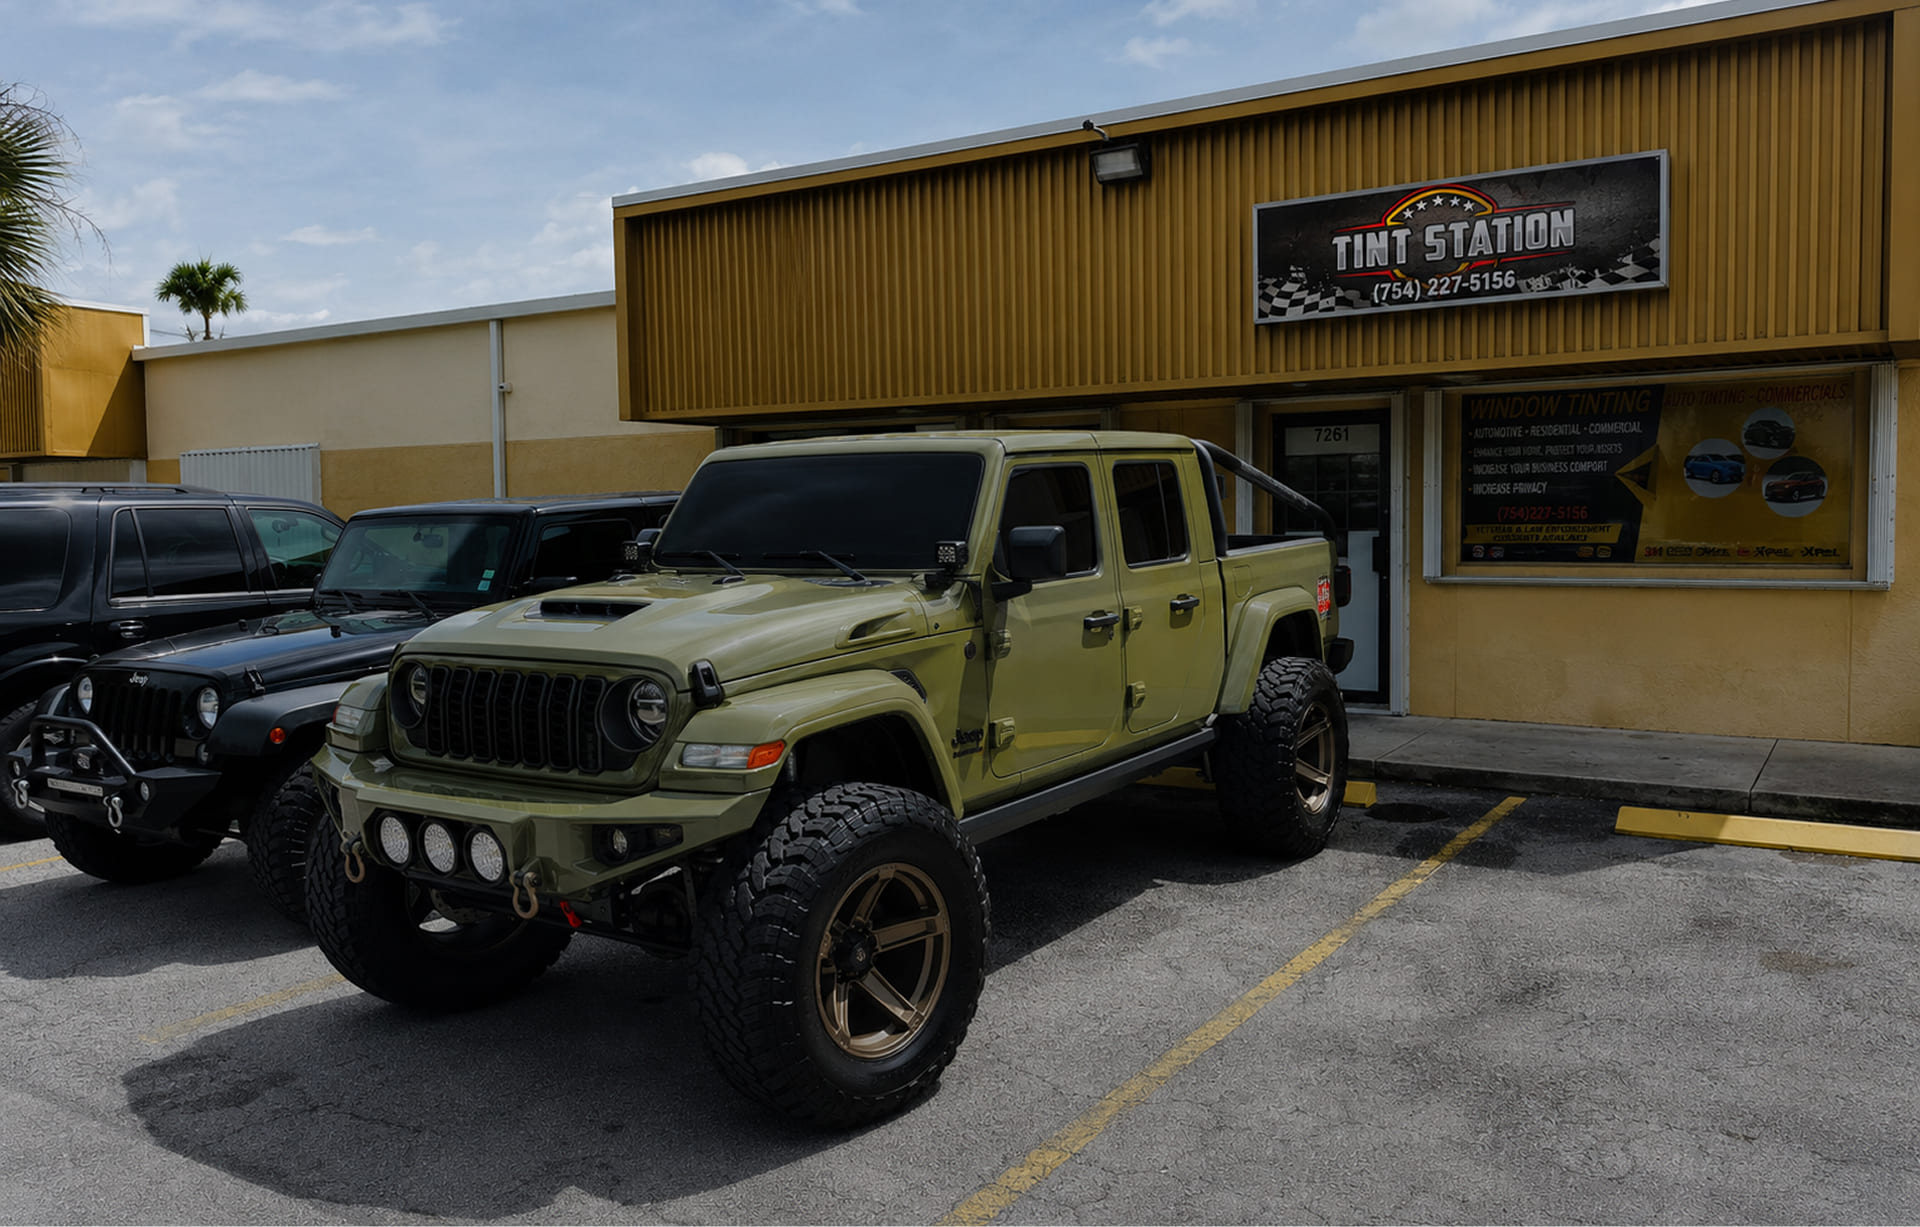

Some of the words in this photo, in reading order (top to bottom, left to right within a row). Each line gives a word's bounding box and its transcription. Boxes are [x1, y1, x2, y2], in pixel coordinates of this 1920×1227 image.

[1332, 227, 1412, 271] TINT
[1424, 208, 1576, 262] STATION
[1373, 279, 1421, 303] (754)
[1427, 270, 1516, 297] 227-5156
[1663, 391, 1695, 406] AUTO
[1699, 389, 1745, 405] TINTING
[1756, 383, 1849, 402] COMMERCIALS
[1470, 394, 1562, 420] WINDOW
[1567, 389, 1652, 416] TINTING
[1314, 427, 1349, 442] 7261
[1473, 425, 1523, 439] AUTOMOTIVE
[1530, 423, 1581, 437] RESIDENTIAL
[1589, 420, 1642, 435] COMMERCIAL
[1473, 463, 1508, 475] INCREASE
[1510, 463, 1530, 474] YOUR
[1531, 462, 1569, 474] BUSINESS
[1473, 482, 1511, 495] INCREASE
[1512, 481, 1548, 495] PRIVACY
[1497, 505, 1590, 521] (754)227-5156
[129, 672, 149, 687] Jeep
[952, 728, 983, 748] Jeep
